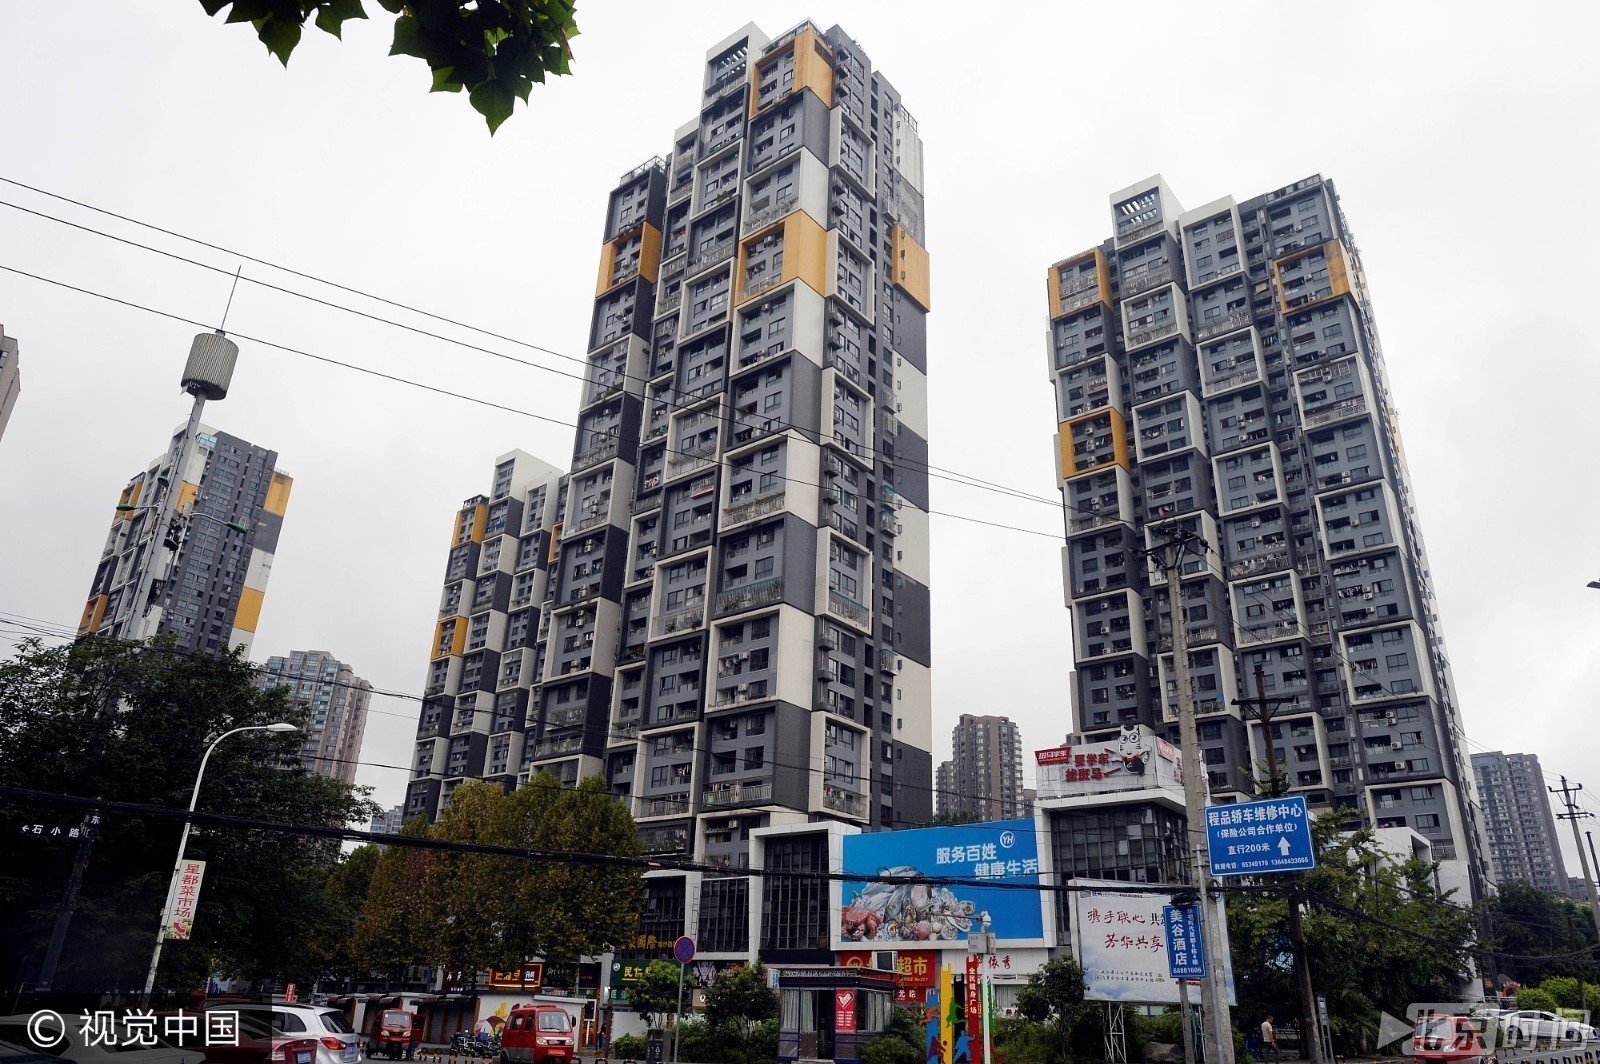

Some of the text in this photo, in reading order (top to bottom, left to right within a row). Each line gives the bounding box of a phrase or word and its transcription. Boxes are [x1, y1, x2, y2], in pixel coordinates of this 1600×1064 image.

[1075, 753, 1109, 766] 要学车
[1066, 768, 1103, 782] 找斑马
[1208, 803, 1303, 826] 程品轿车维修中心
[32, 824, 80, 838] 石小路
[936, 843, 997, 864] 服务百姓
[1228, 843, 1270, 855] 直行200米
[974, 858, 1038, 880] 健康生活
[173, 863, 200, 918] 星都菜市场
[1087, 908, 1146, 924] 携手联心
[1104, 932, 1164, 953] 芳华共享
[1169, 909, 1188, 966] 美谷酒店
[968, 967, 978, 1014] 全民健身广场
